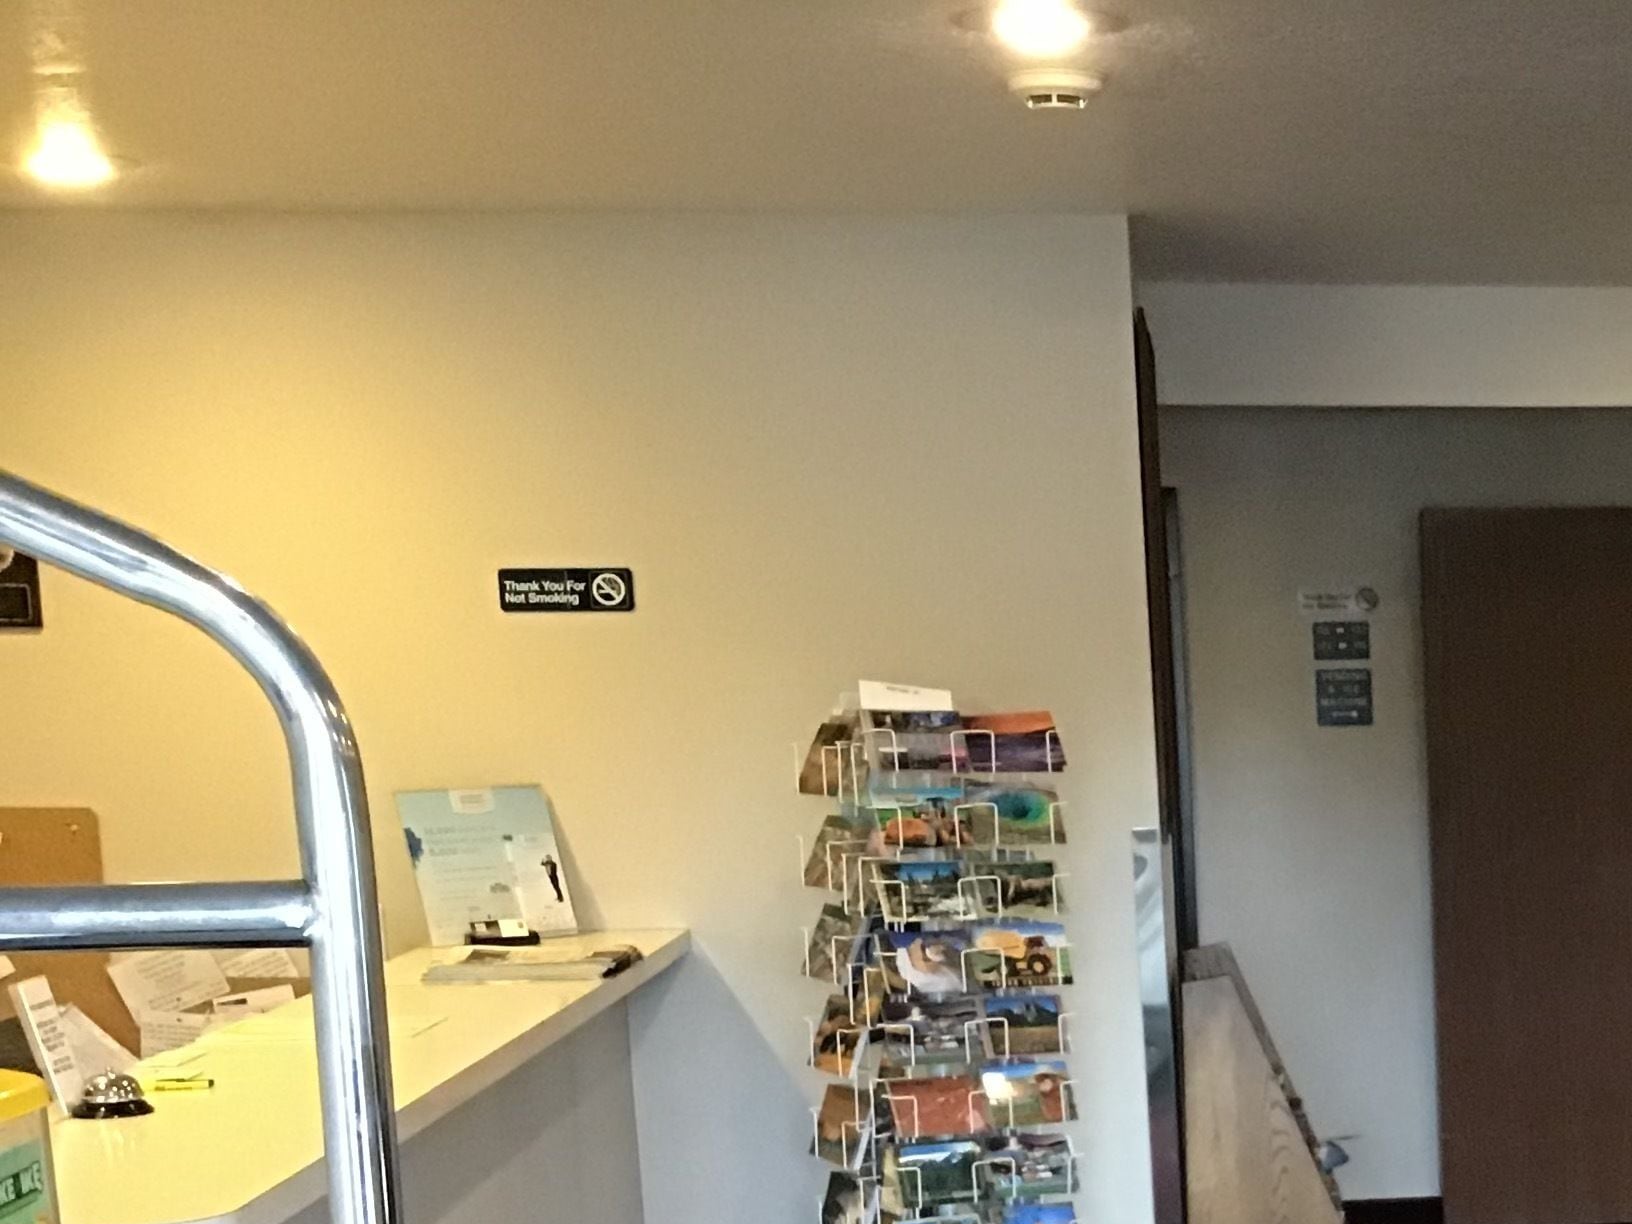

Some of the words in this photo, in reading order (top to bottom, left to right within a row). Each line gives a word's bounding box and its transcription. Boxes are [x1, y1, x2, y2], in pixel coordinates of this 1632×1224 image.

[504, 580, 540, 591] Thank
[542, 580, 564, 591] You
[566, 580, 586, 591] For
[505, 592, 526, 603] Not
[528, 592, 579, 605] Smoking
